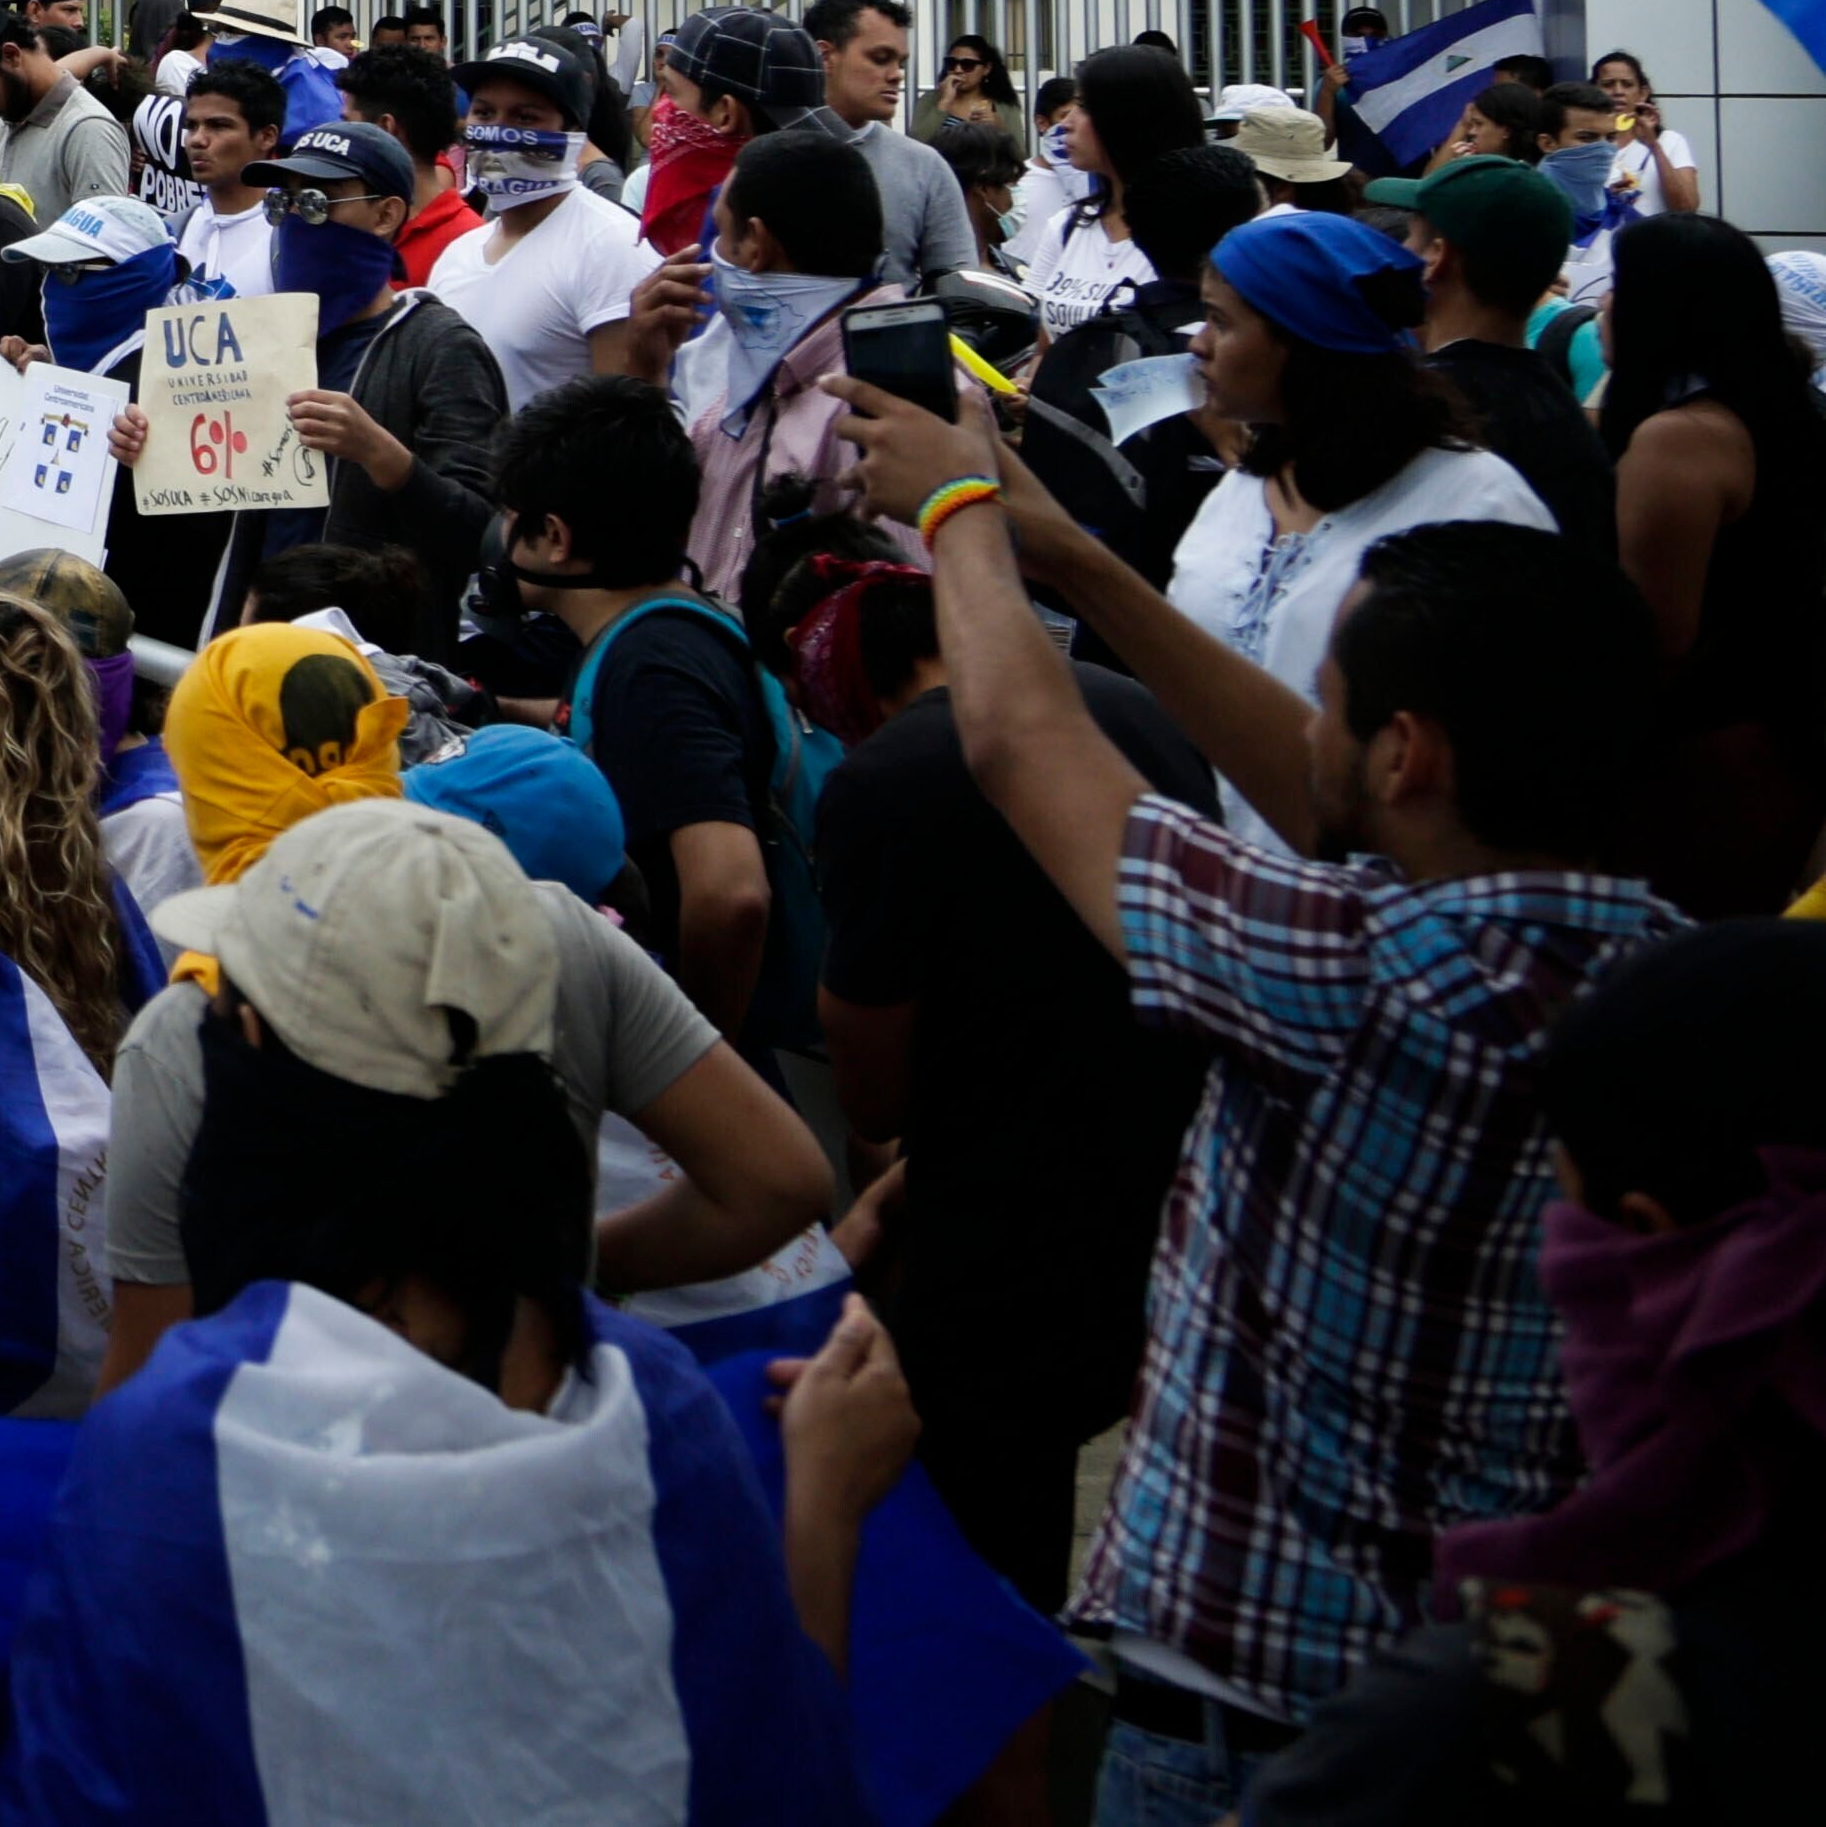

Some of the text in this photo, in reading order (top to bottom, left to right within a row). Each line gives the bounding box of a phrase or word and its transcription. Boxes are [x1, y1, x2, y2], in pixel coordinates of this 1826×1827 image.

[133, 94, 183, 170] NO
[312, 134, 353, 157] UCA
[466, 124, 539, 146] SOMOS
[163, 312, 244, 368] UCA
[167, 369, 249, 389] UNIVERSIDAD
[190, 409, 248, 480] 6%
